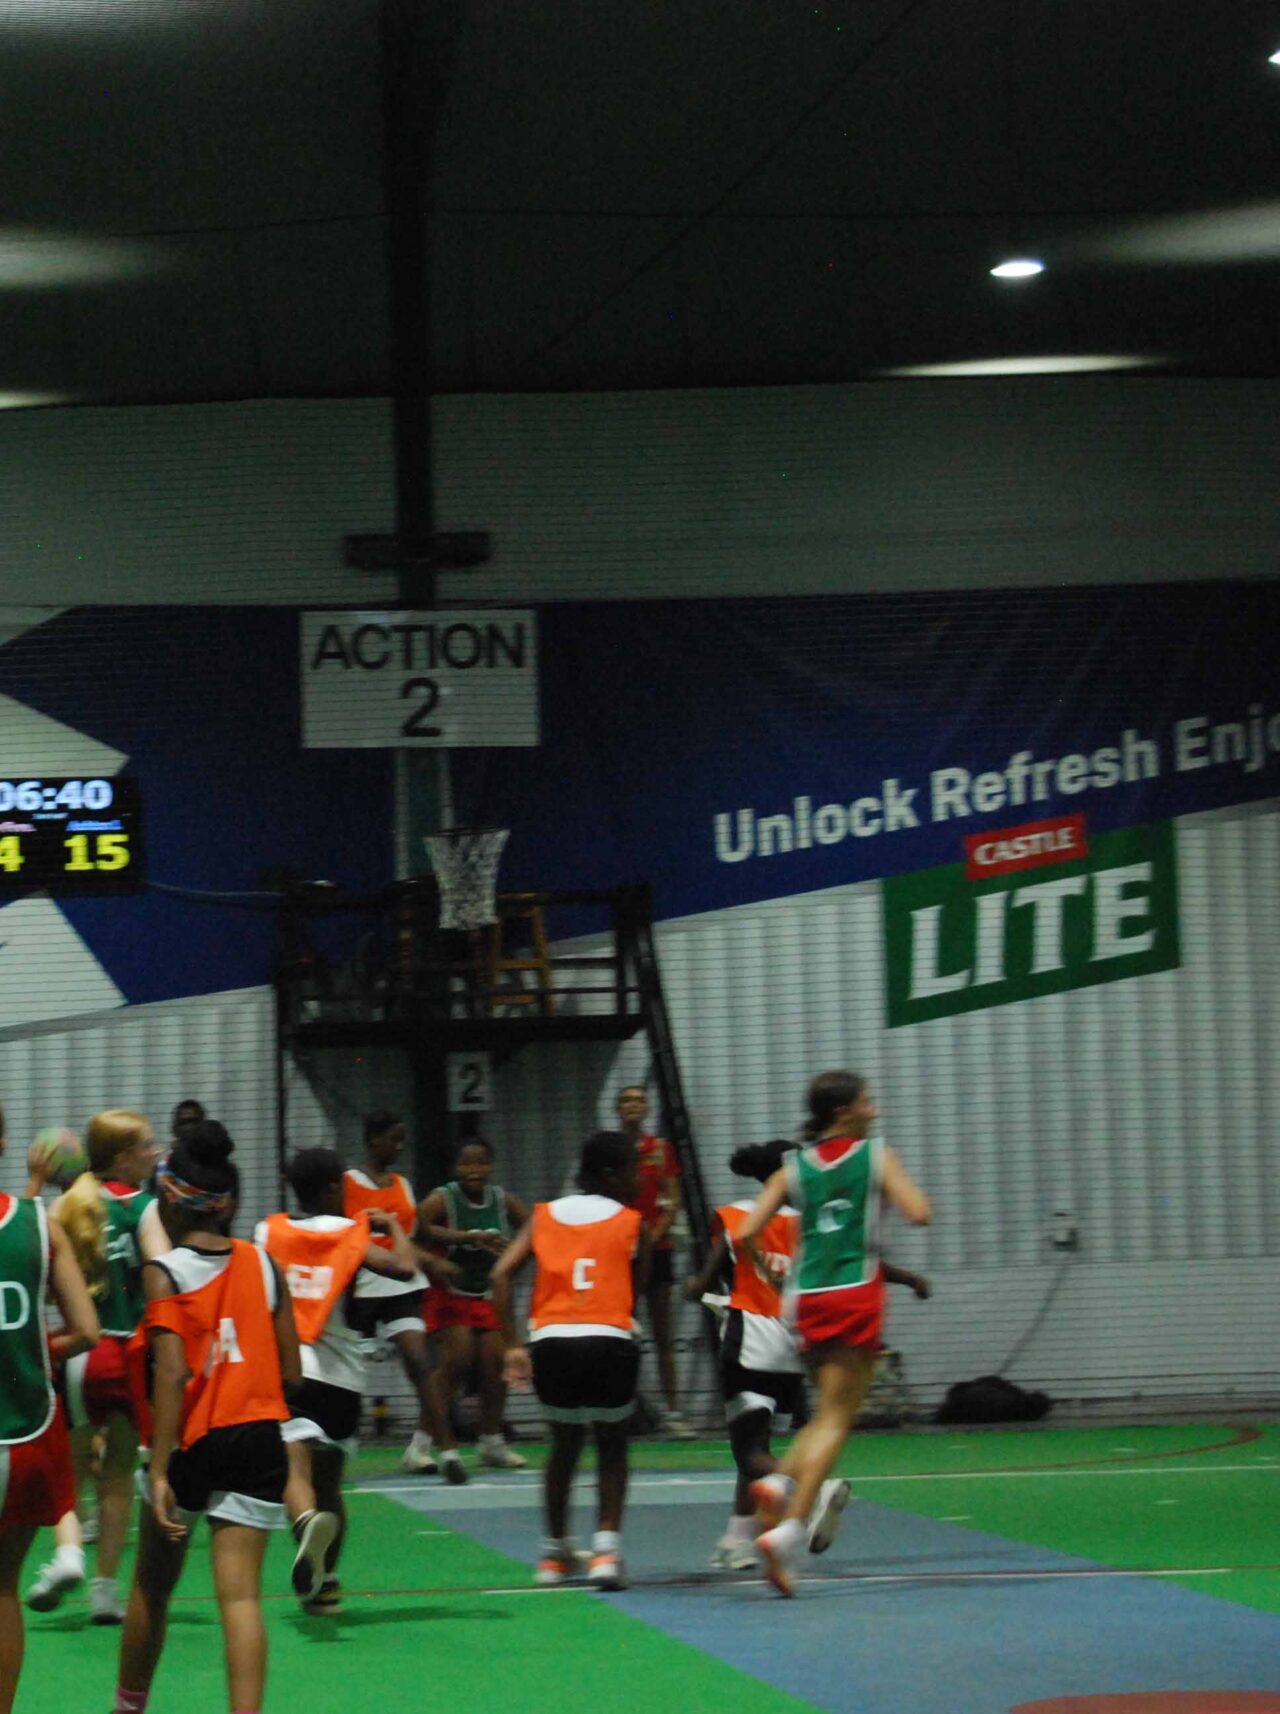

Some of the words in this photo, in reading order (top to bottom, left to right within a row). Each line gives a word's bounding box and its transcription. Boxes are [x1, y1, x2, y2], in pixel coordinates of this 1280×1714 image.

[310, 622, 526, 670] ACTION
[401, 677, 442, 737] 2
[713, 776, 921, 863] Unlock
[929, 728, 1160, 822] Refresh
[63, 833, 131, 872] 15
[972, 826, 1078, 867] CASTLE
[906, 860, 1158, 1001] LITE
[459, 1064, 482, 1103] 2
[572, 1257, 597, 1291] C
